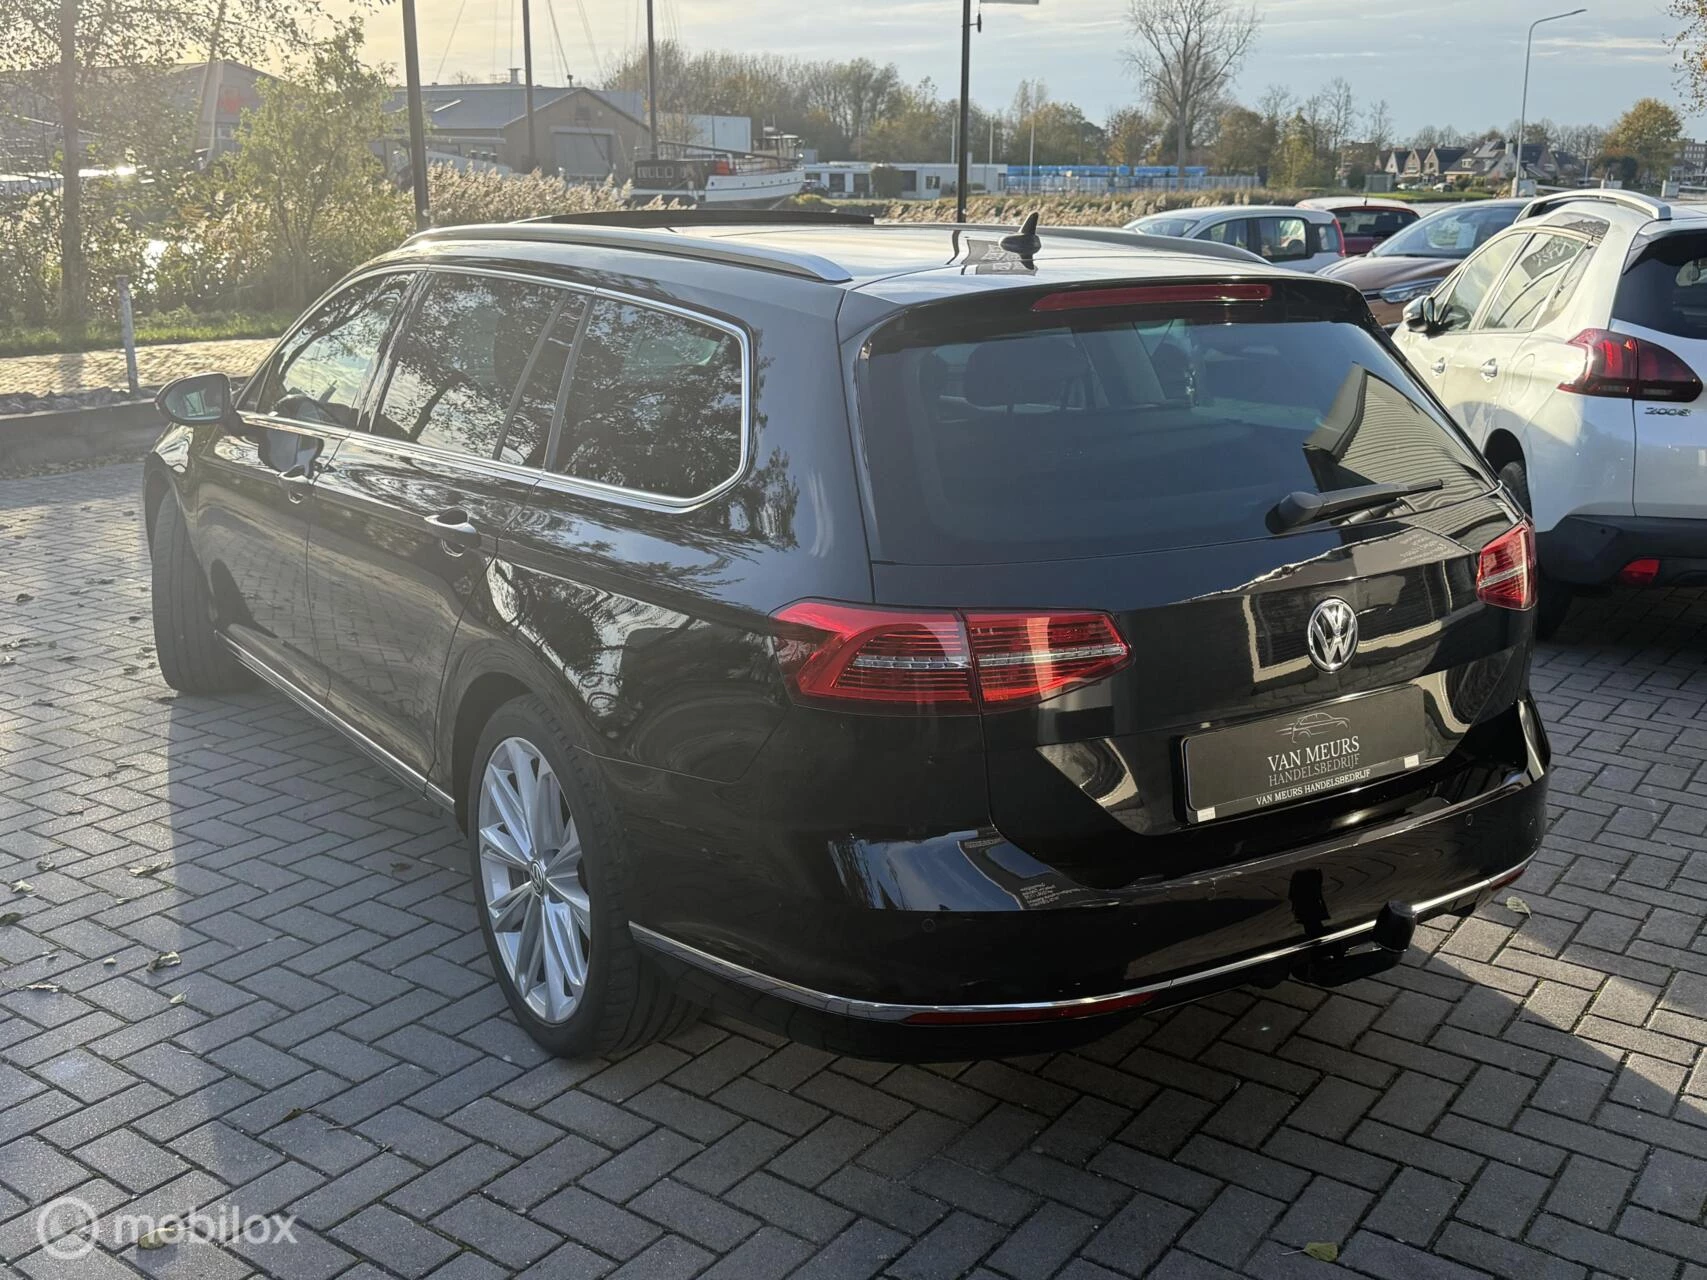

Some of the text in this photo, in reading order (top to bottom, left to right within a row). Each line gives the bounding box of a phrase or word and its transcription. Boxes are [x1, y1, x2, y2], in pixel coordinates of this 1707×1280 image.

[1267, 735, 1360, 772] VAN MEURS
[1268, 753, 1361, 787] HANDELSBEDRIJF
[1256, 768, 1371, 806] VAN MEURS HANDELSBEDRIJF
